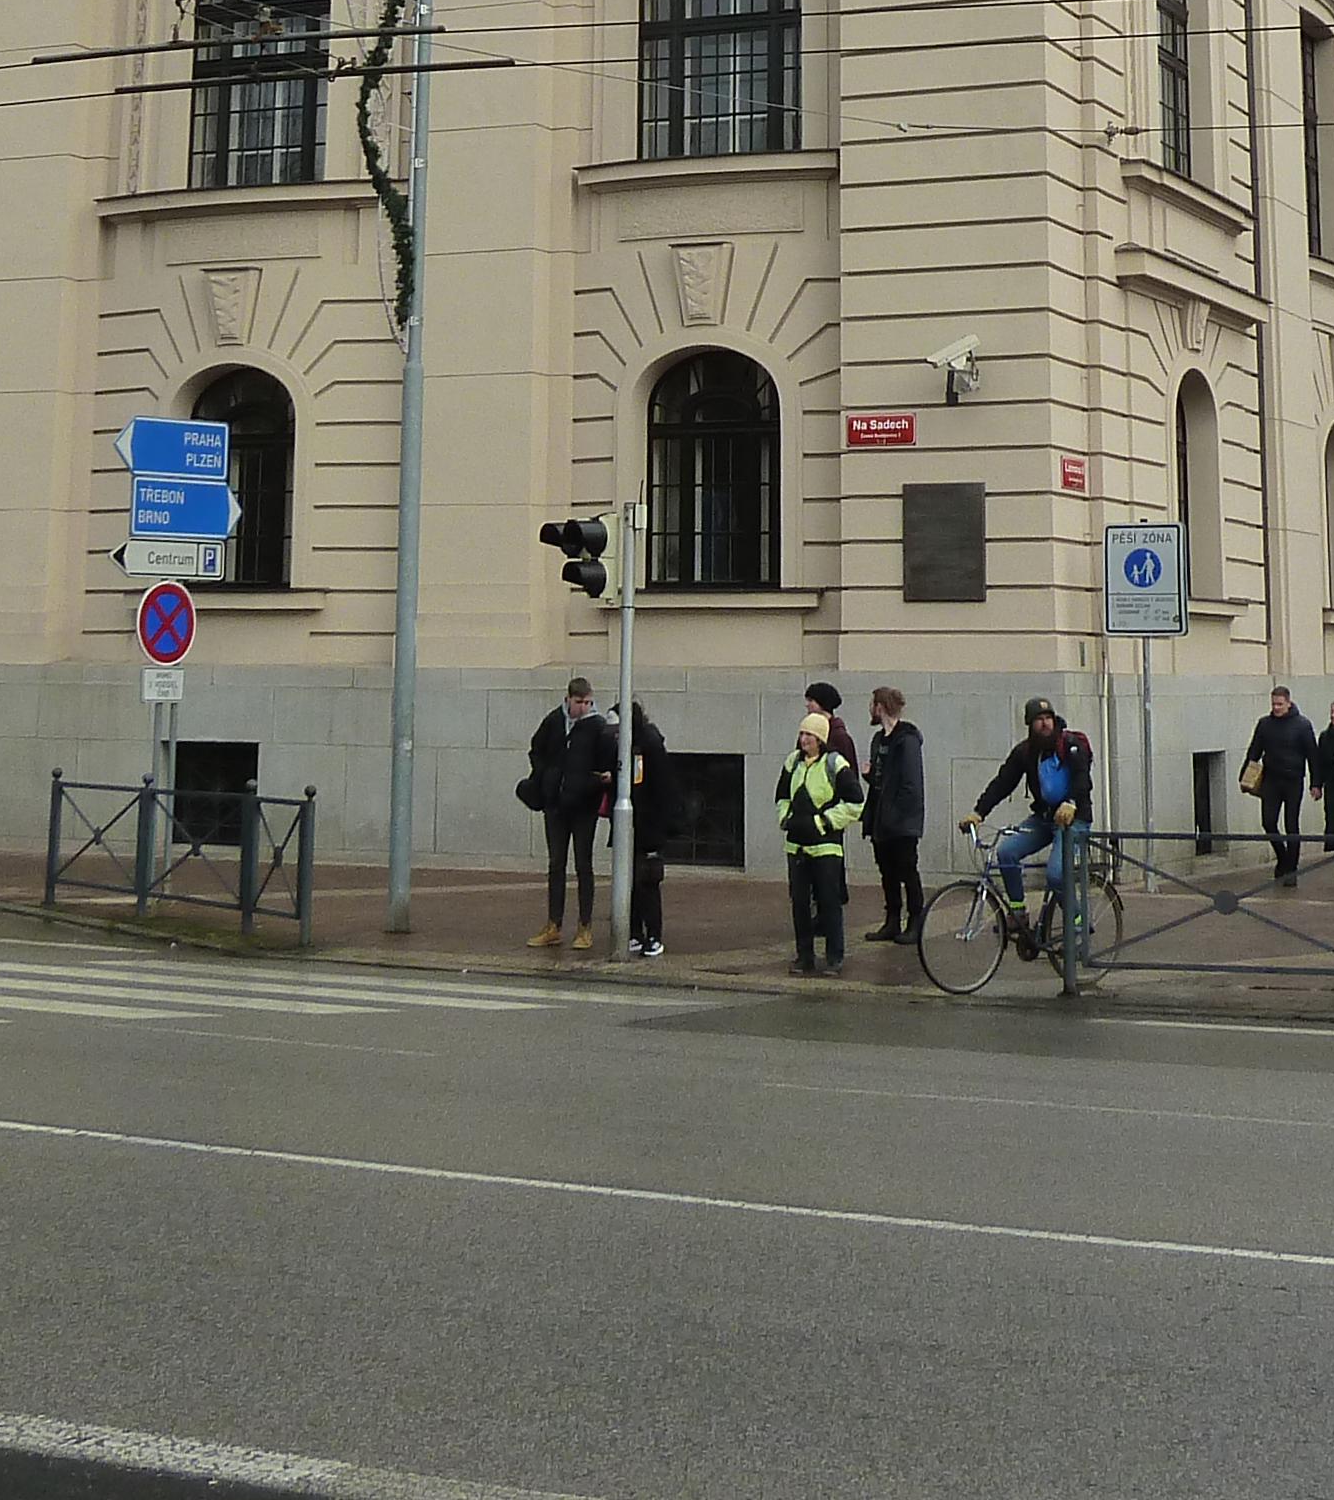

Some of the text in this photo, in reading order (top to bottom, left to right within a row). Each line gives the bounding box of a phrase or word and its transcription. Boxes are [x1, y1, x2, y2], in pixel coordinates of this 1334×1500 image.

[852, 417, 909, 431] Na Sadech
[183, 431, 223, 448] PRAHA
[185, 451, 223, 469] PLZEŇ
[138, 484, 185, 505] TŘEBOŇ
[137, 509, 171, 525] BRNO
[1111, 531, 1173, 544] PĚŠÍ ZÓNA
[147, 550, 195, 566] Centrum
